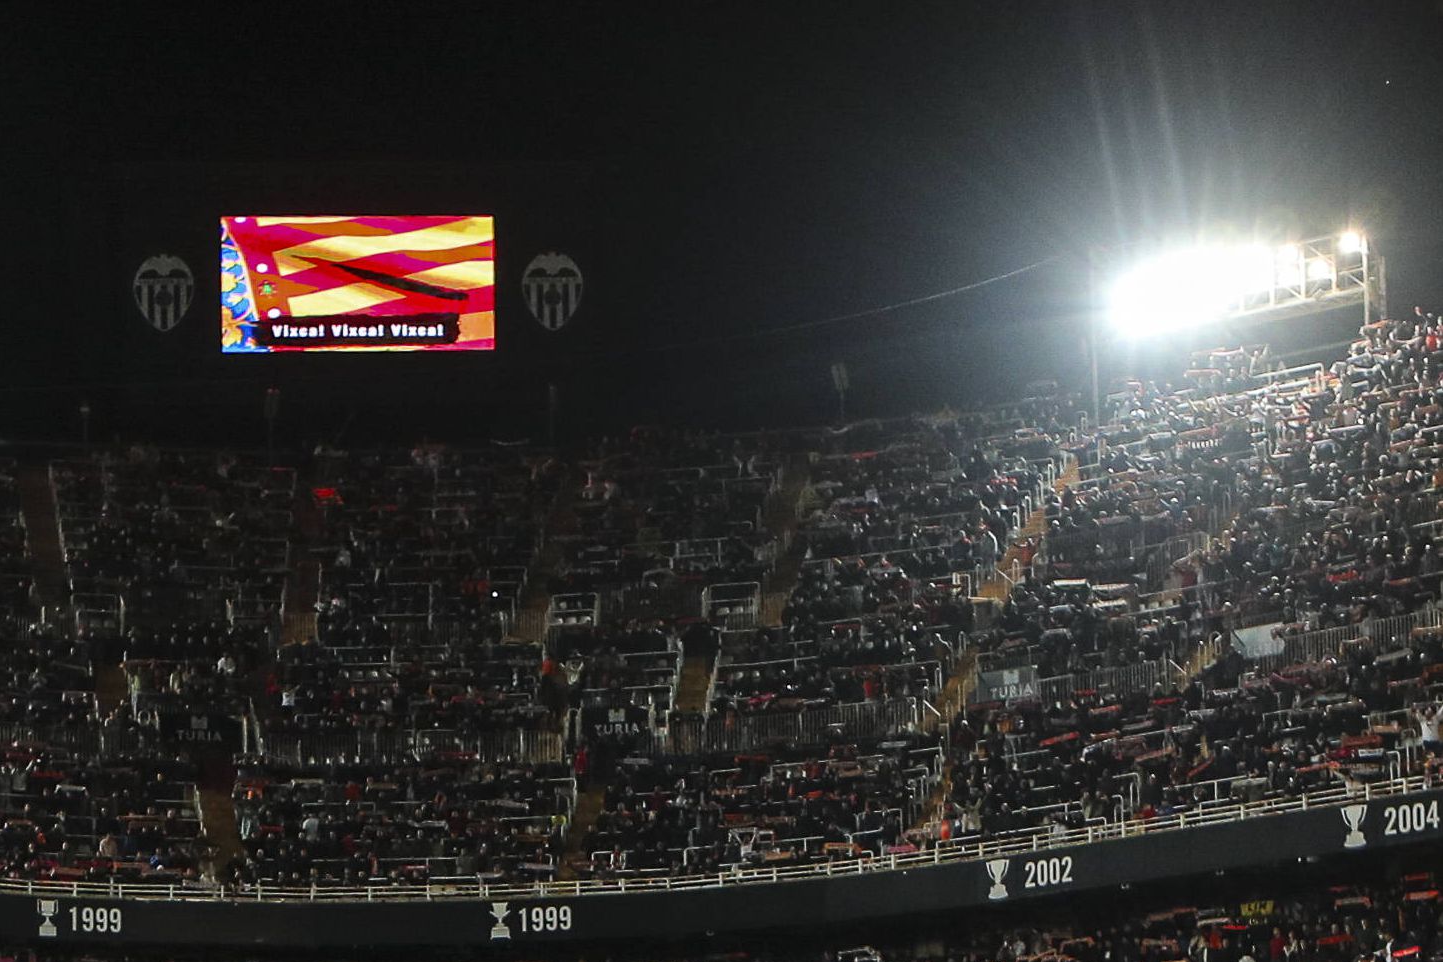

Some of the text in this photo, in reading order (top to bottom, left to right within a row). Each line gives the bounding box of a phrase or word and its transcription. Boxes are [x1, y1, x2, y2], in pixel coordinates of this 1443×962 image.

[1384, 801, 1441, 836] 2004
[1024, 855, 1073, 888] 2002
[69, 906, 122, 933] 1999
[518, 905, 572, 932] 1999
